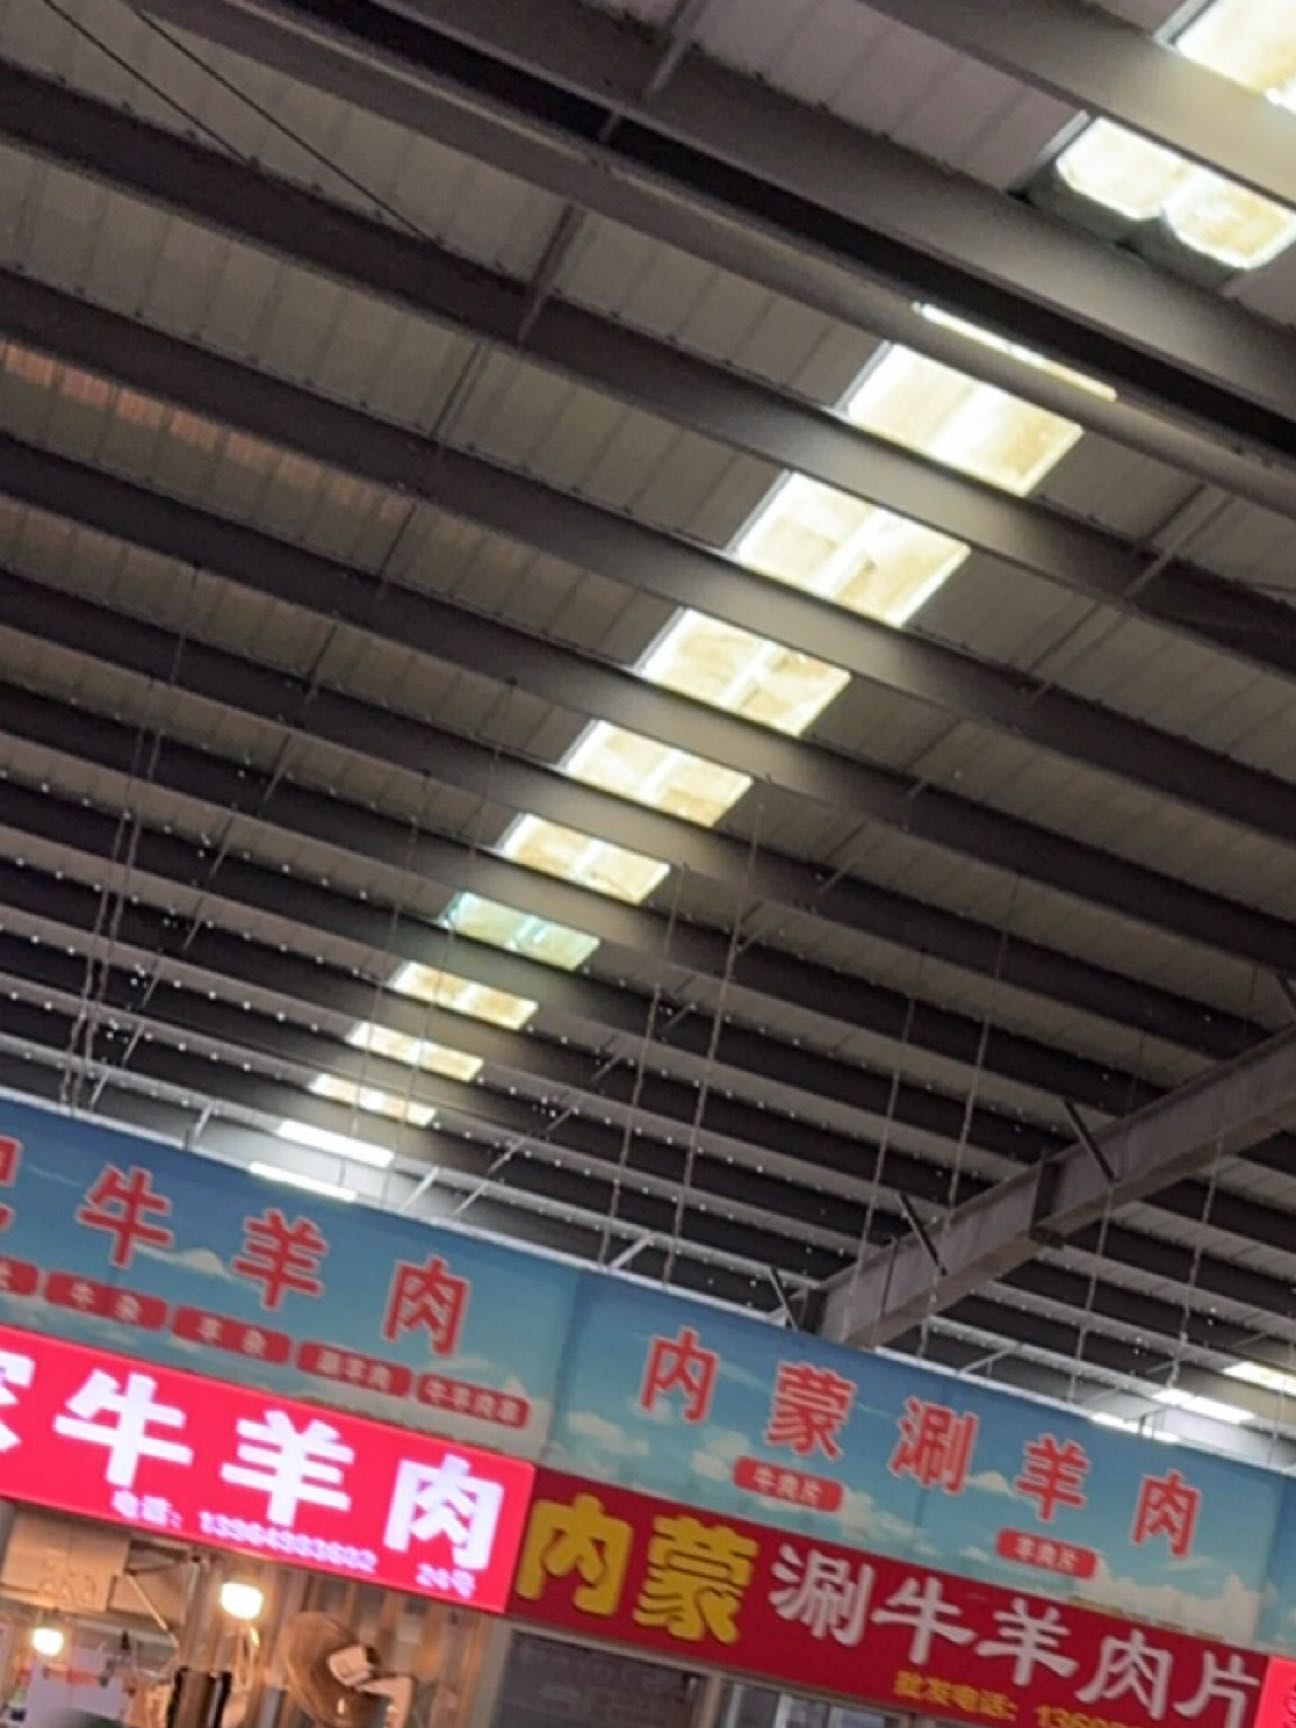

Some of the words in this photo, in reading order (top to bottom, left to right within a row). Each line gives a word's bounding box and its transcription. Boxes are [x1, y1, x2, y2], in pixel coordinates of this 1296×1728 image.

[0, 1136, 470, 1356] 牛羊肉
[638, 1325, 1203, 1558] 内蒙涮羊肉
